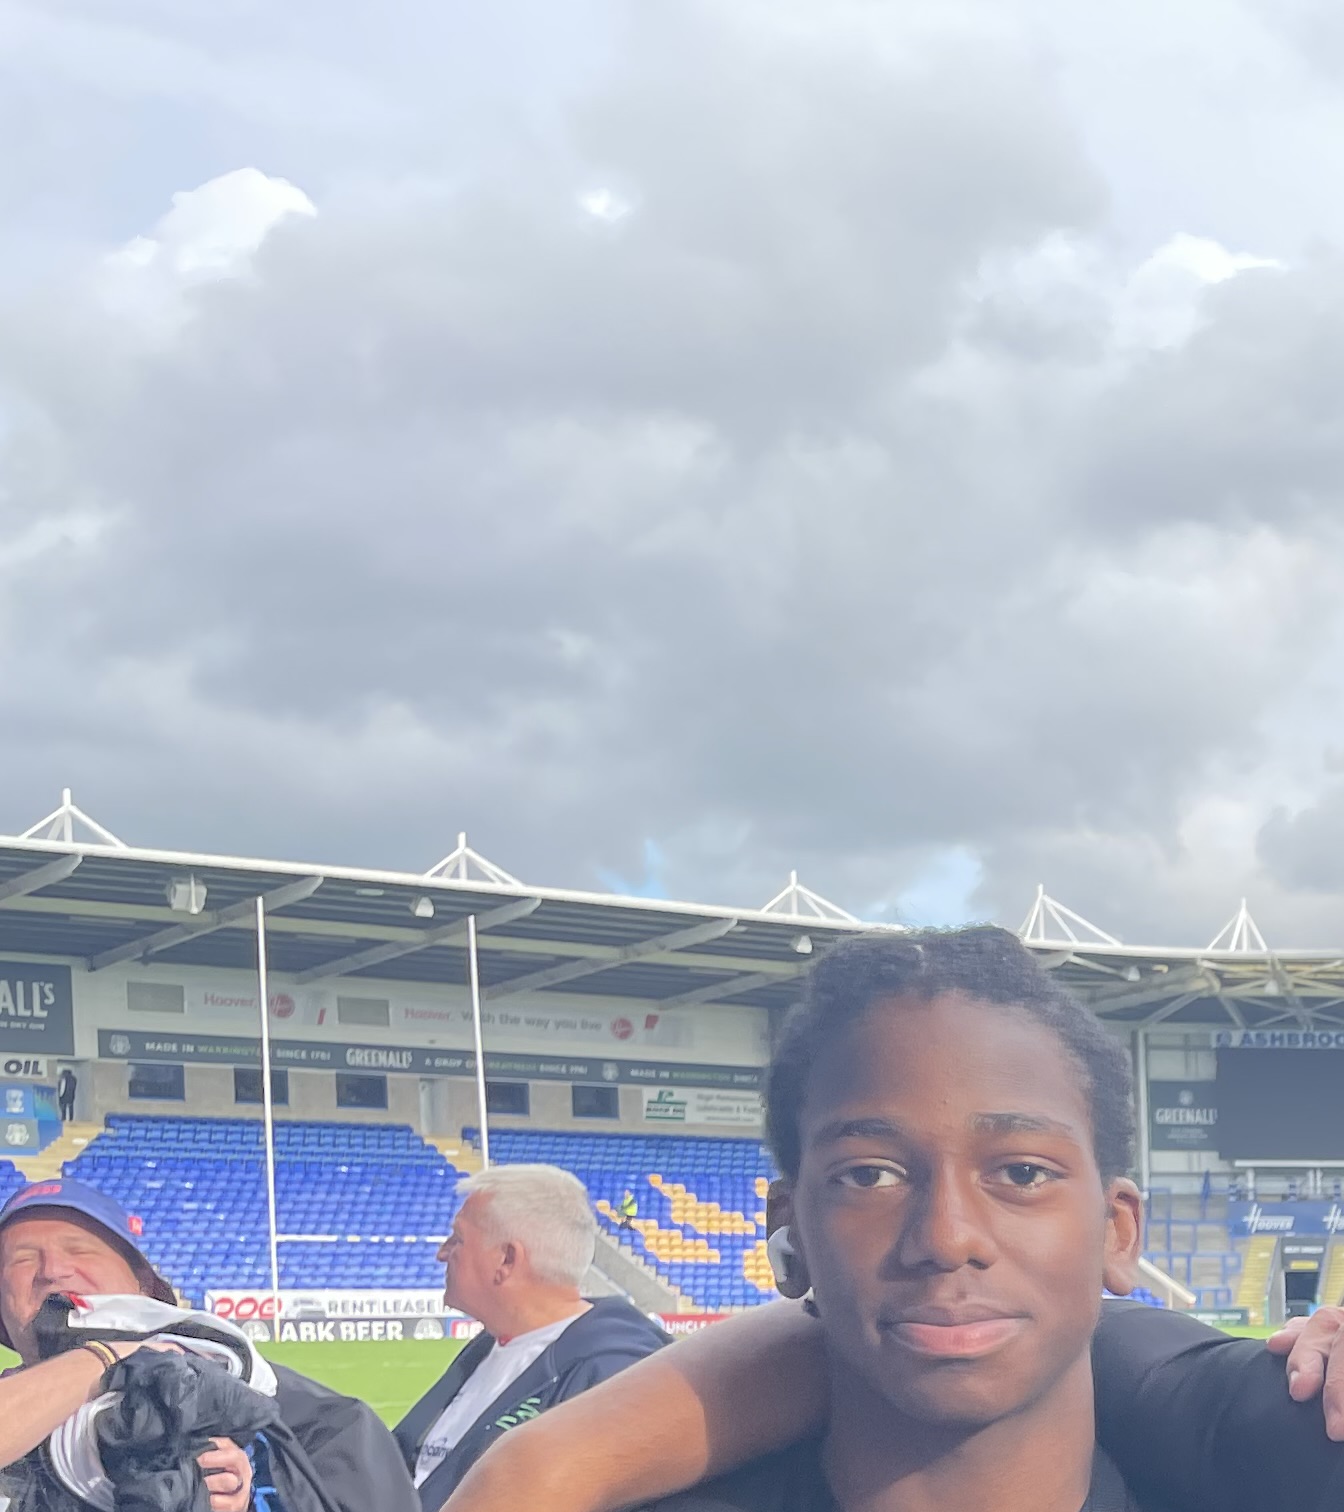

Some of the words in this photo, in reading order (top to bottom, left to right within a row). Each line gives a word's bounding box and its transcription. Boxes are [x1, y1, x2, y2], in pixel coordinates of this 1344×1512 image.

[4, 1060, 43, 1076] OIL
[328, 1299, 375, 1314] RENT
[383, 1300, 434, 1315] LEASE
[339, 1320, 404, 1341] BEER
